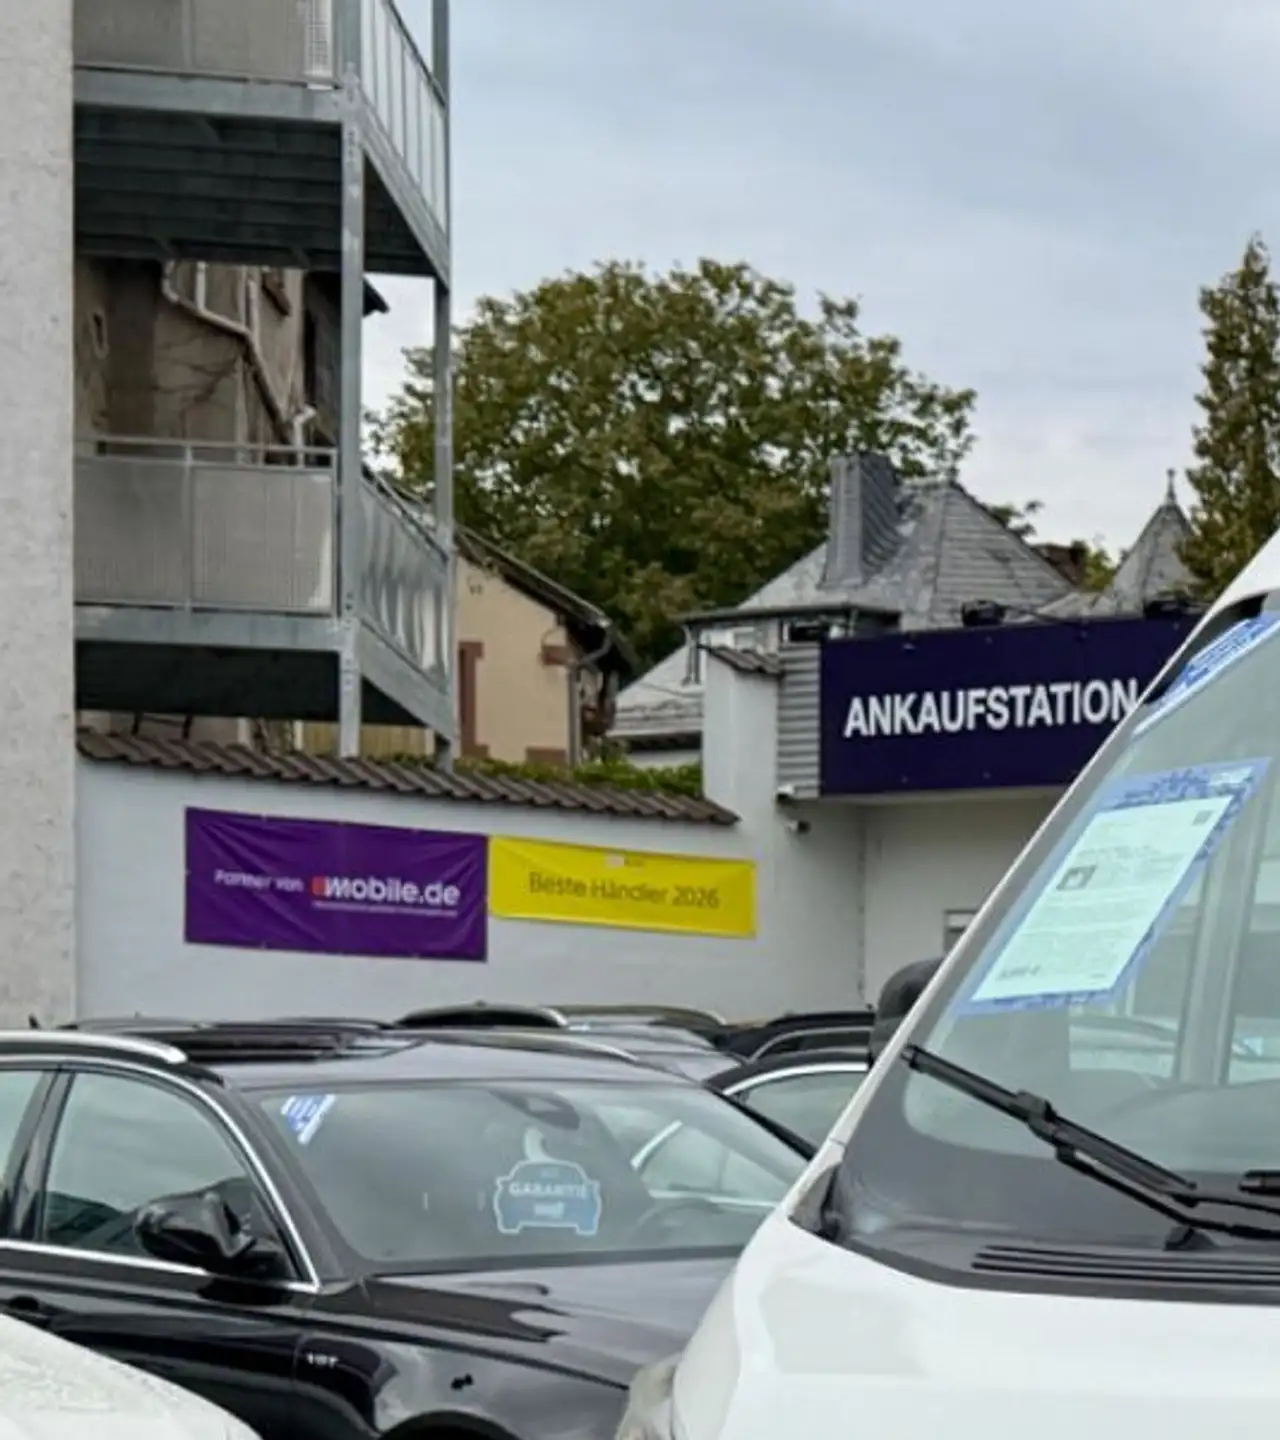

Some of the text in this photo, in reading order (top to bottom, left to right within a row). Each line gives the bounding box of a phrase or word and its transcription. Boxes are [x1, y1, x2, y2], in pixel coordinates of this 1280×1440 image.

[844, 678, 1138, 738] ANKAUFSTATION
[322, 876, 461, 906] mobile.de
[529, 871, 720, 909] Beste Händler 2026
